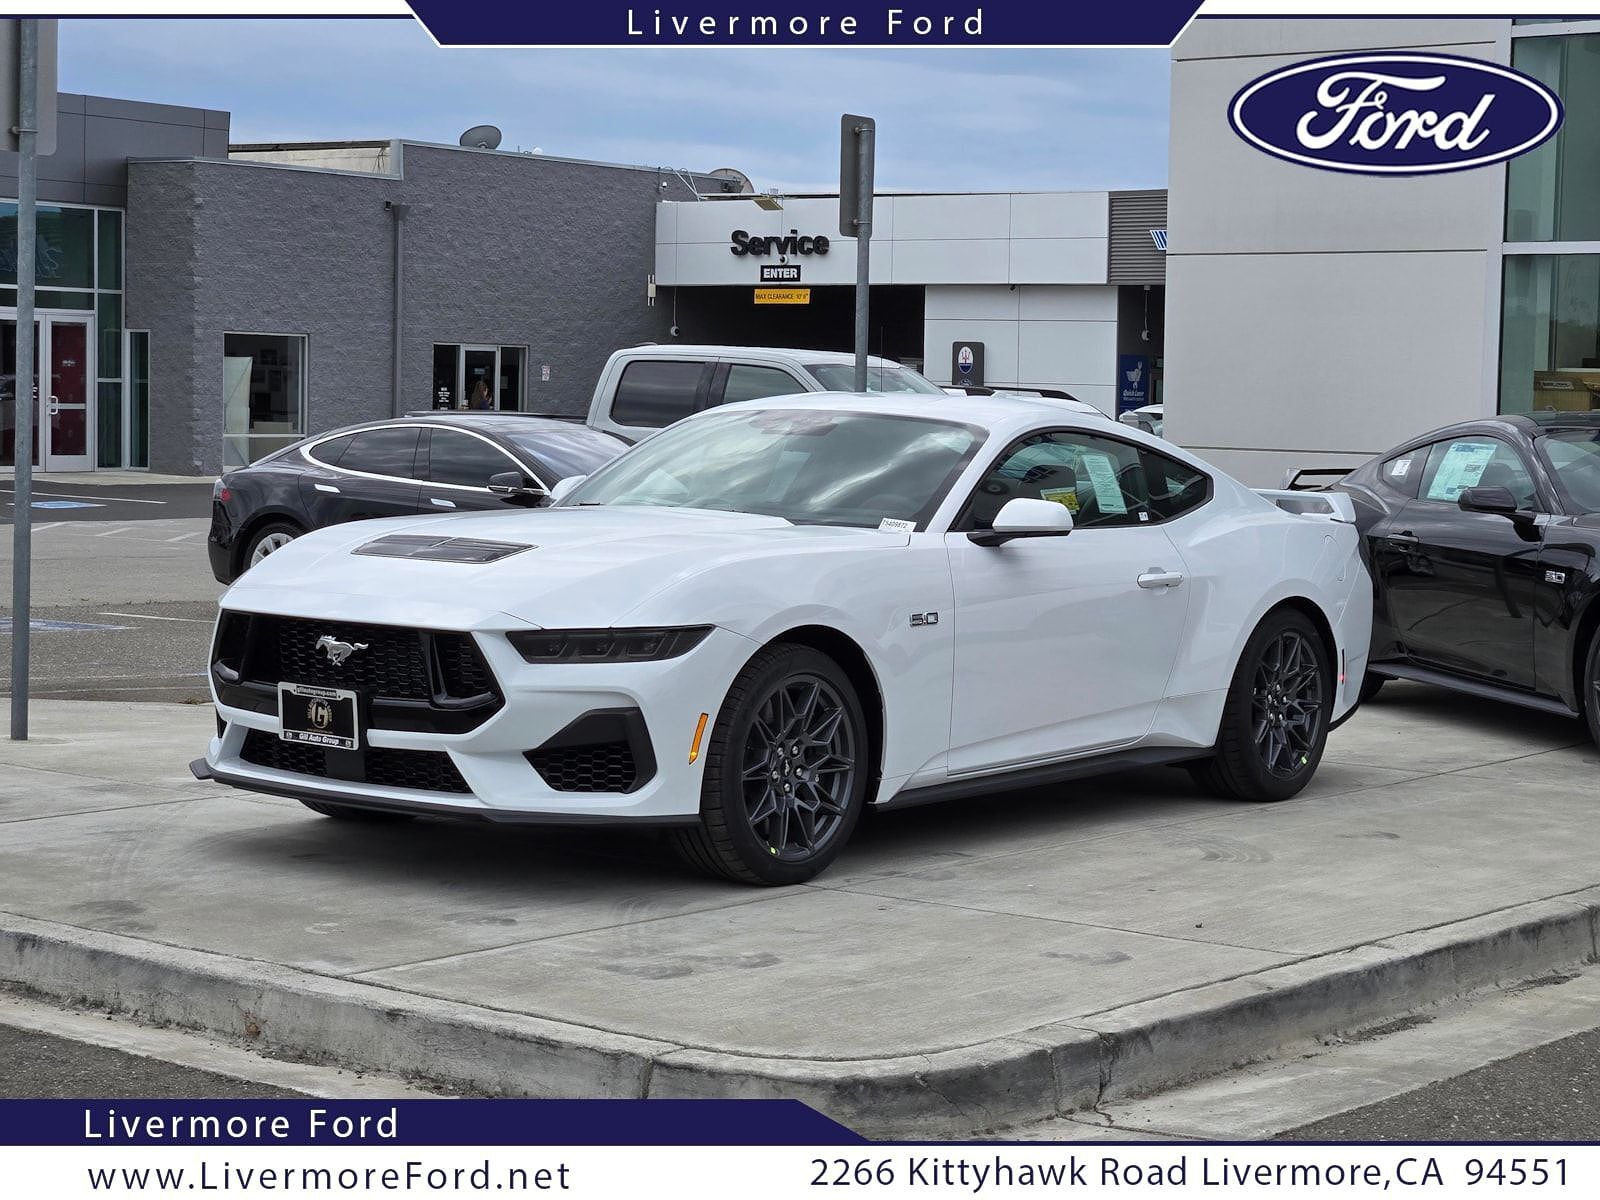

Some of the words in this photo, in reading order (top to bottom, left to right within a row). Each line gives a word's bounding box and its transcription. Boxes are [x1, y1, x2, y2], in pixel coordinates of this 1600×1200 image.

[730, 229, 830, 256] Service
[763, 267, 798, 279] ENTER
[910, 612, 939, 626] 5.0
[298, 733, 309, 741] Gill
[308, 734, 322, 743] Auto
[322, 736, 340, 746] Group
